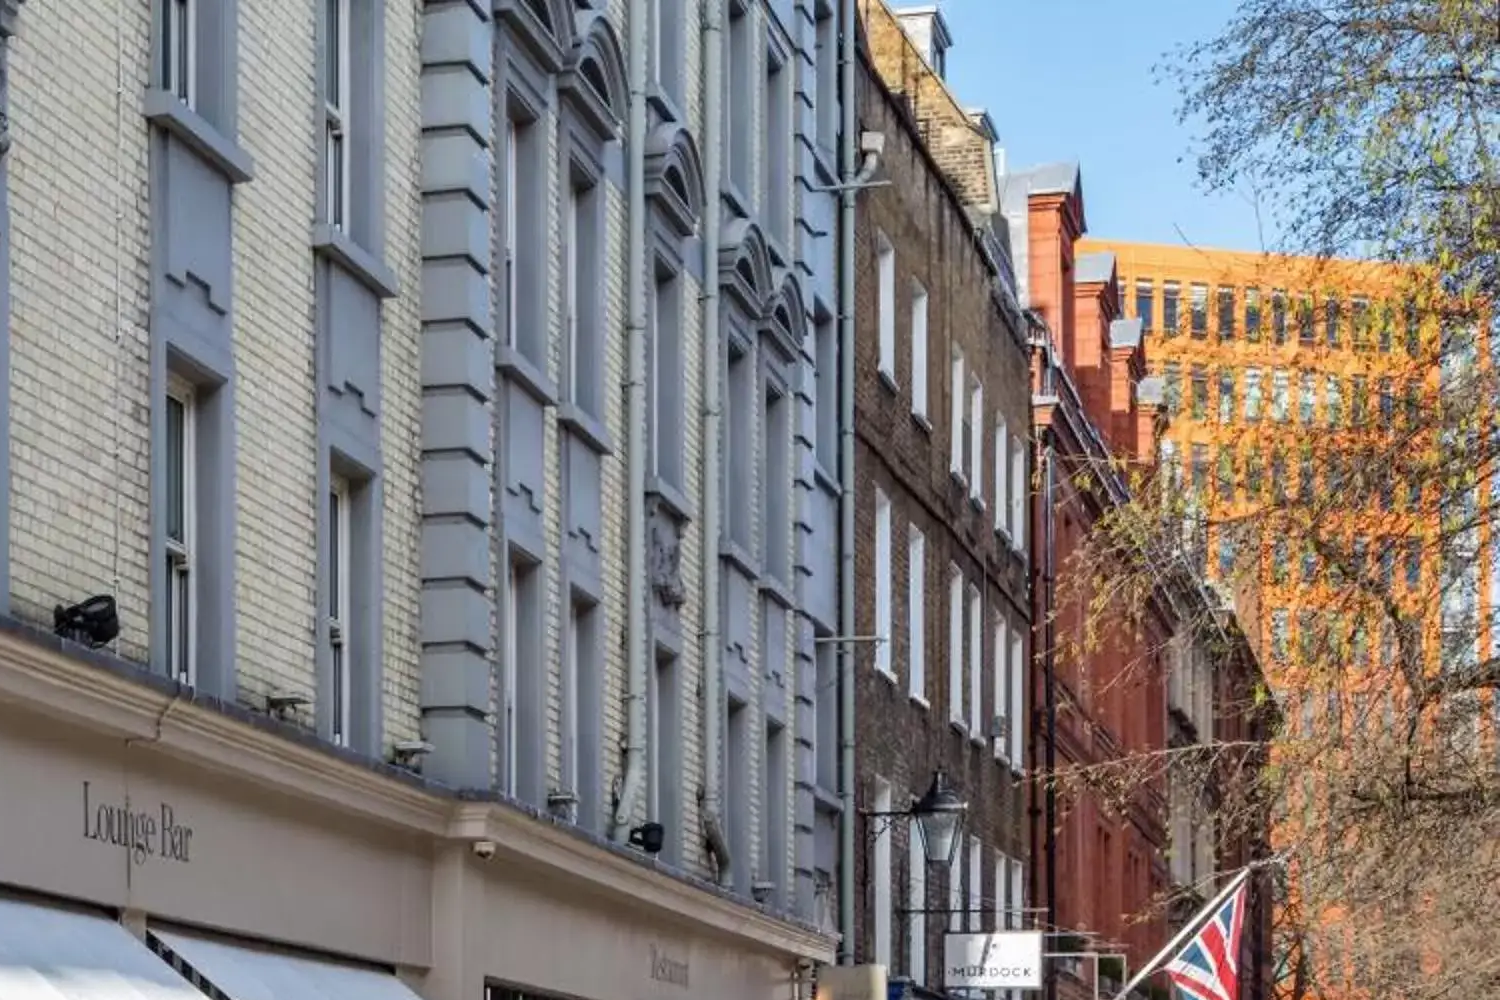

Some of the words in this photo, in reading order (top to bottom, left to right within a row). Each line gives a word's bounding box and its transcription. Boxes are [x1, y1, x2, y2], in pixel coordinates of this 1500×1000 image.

[83, 781, 156, 865] Lounge
[160, 802, 193, 863] Bar
[953, 967, 1032, 977] MURDOCK
